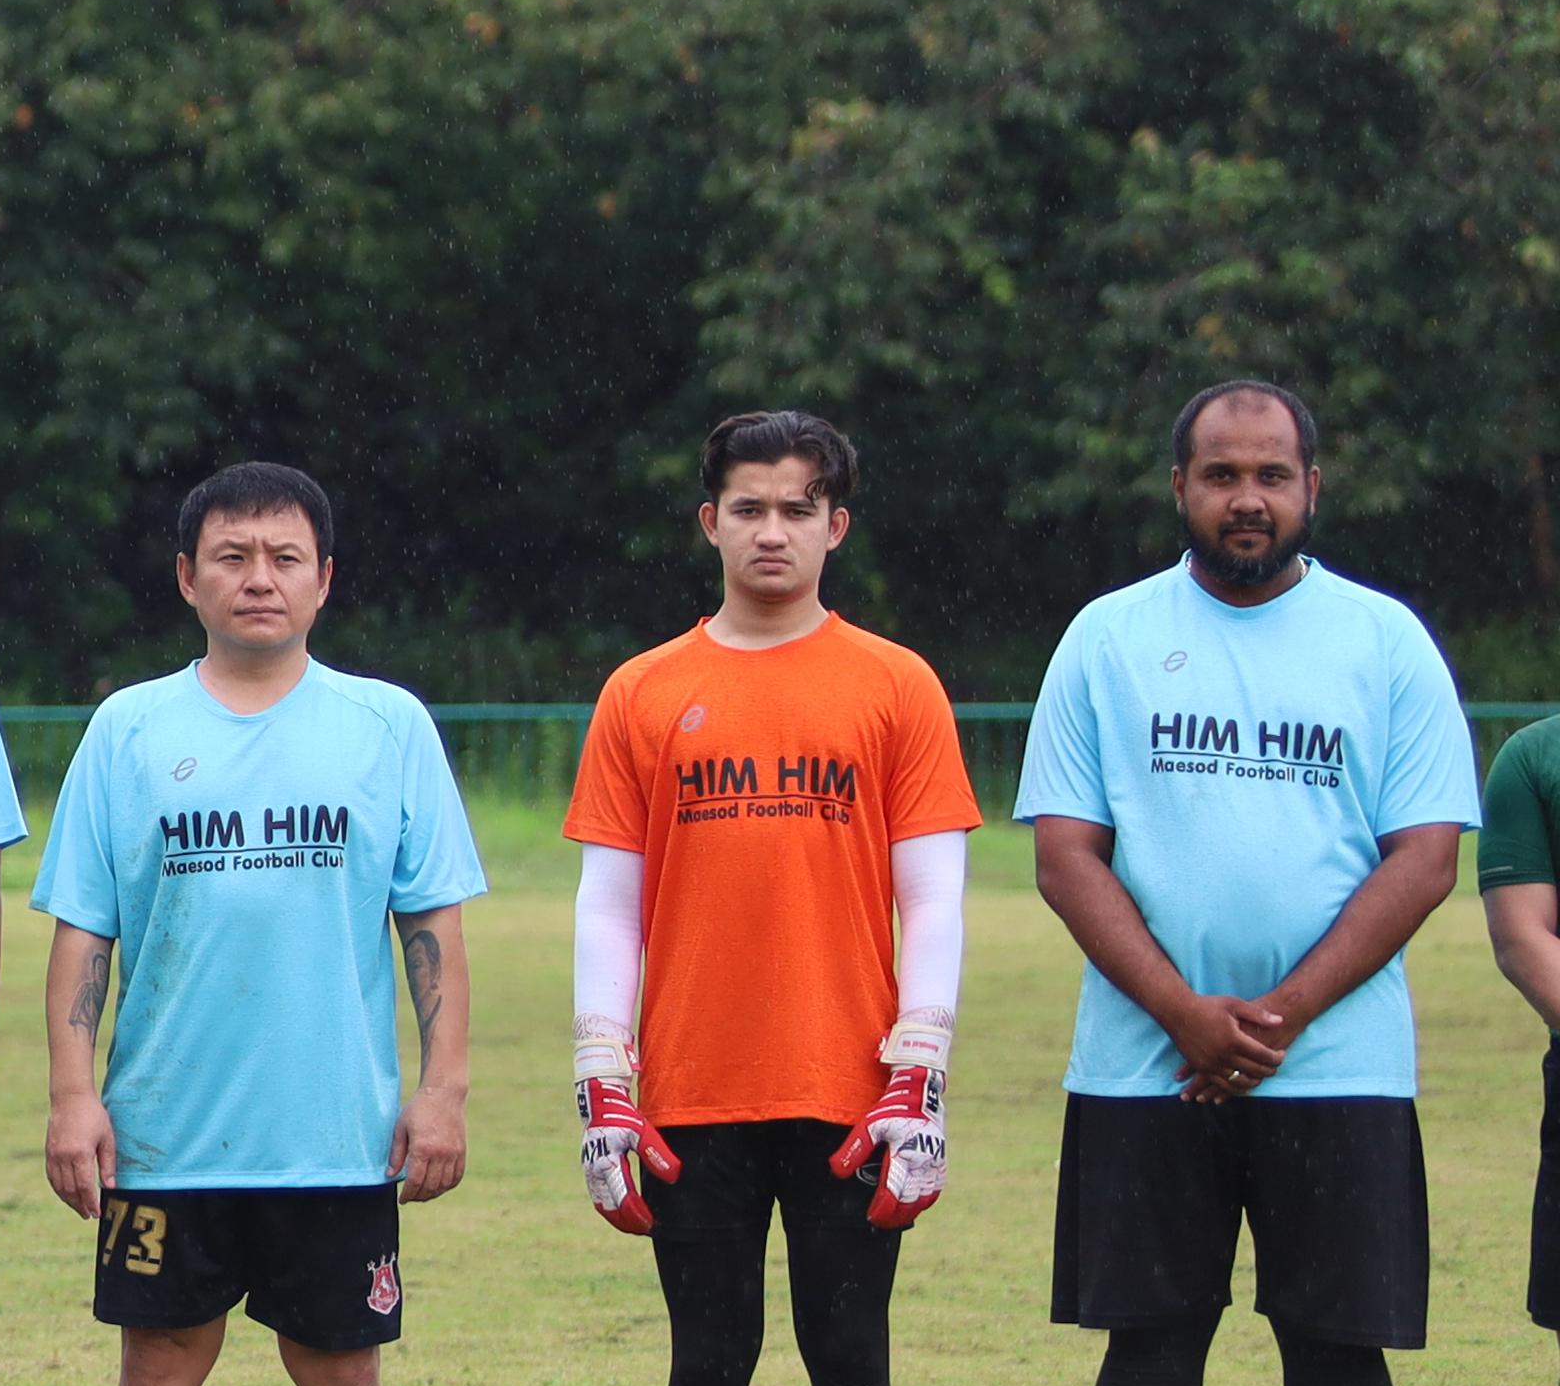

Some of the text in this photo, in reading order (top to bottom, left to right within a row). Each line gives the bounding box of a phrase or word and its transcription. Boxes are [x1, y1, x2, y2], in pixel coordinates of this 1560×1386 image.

[1151, 713, 1343, 765] HIM HIM
[676, 756, 855, 802] HIM HIM
[1151, 758, 1339, 788] Maesod Football Club
[159, 805, 348, 851] HIM HIM
[678, 803, 739, 825] Maesod
[747, 801, 813, 817] Football
[162, 851, 343, 877] Maesod Football Clu
[102, 1199, 167, 1275] 73
